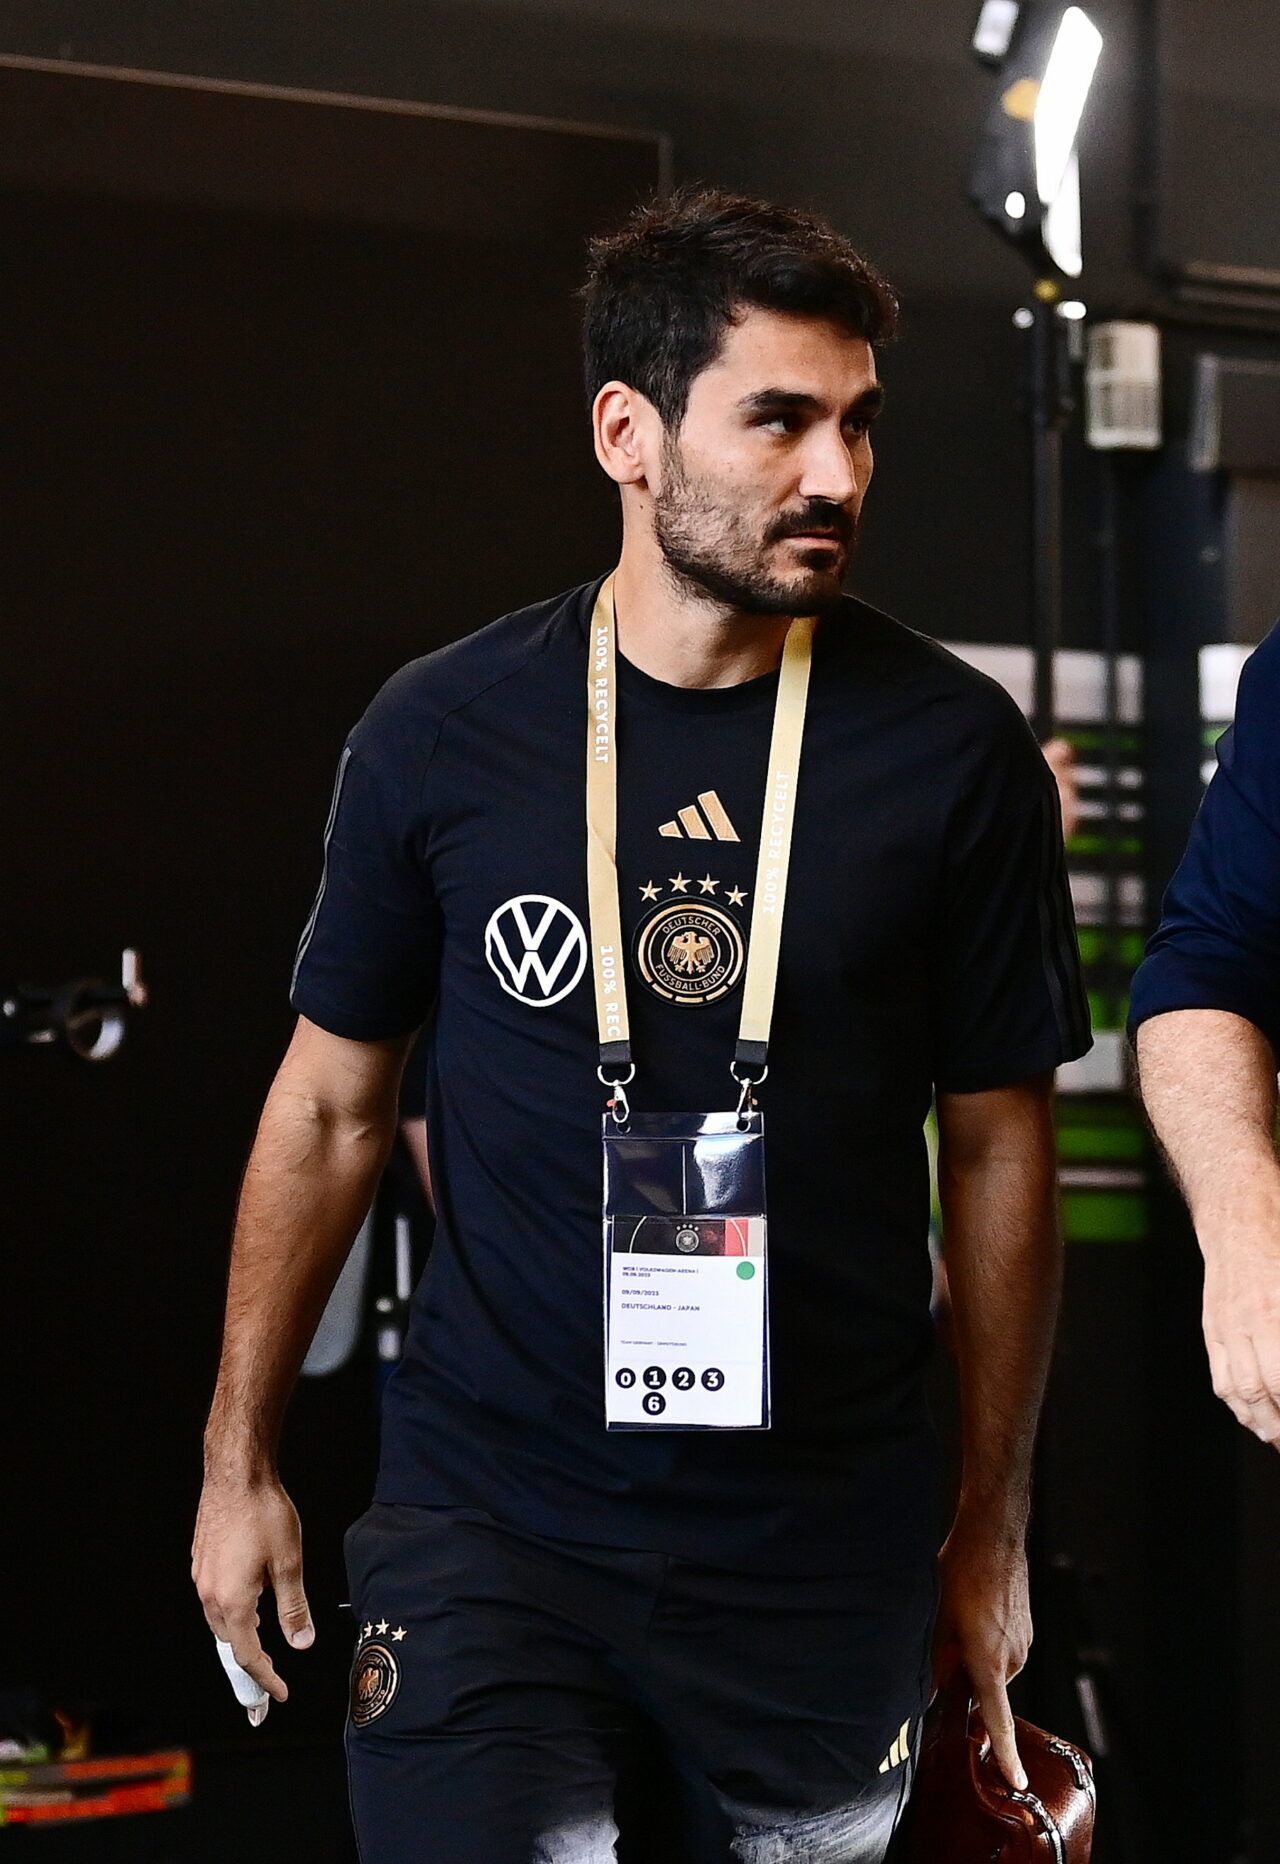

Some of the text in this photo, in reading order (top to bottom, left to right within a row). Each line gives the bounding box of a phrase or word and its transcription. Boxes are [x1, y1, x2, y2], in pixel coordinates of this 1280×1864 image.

[595, 626, 609, 764] 100% RECYCELT
[762, 770, 791, 916] 100% RECYCELT
[662, 916, 721, 936] DEUTSCHER
[600, 945, 621, 1037] 100% REC
[655, 963, 726, 991] FUSSBALL-BUND
[621, 1302, 672, 1311] DEUTSCHLAND
[677, 1304, 700, 1312] JAPAN
